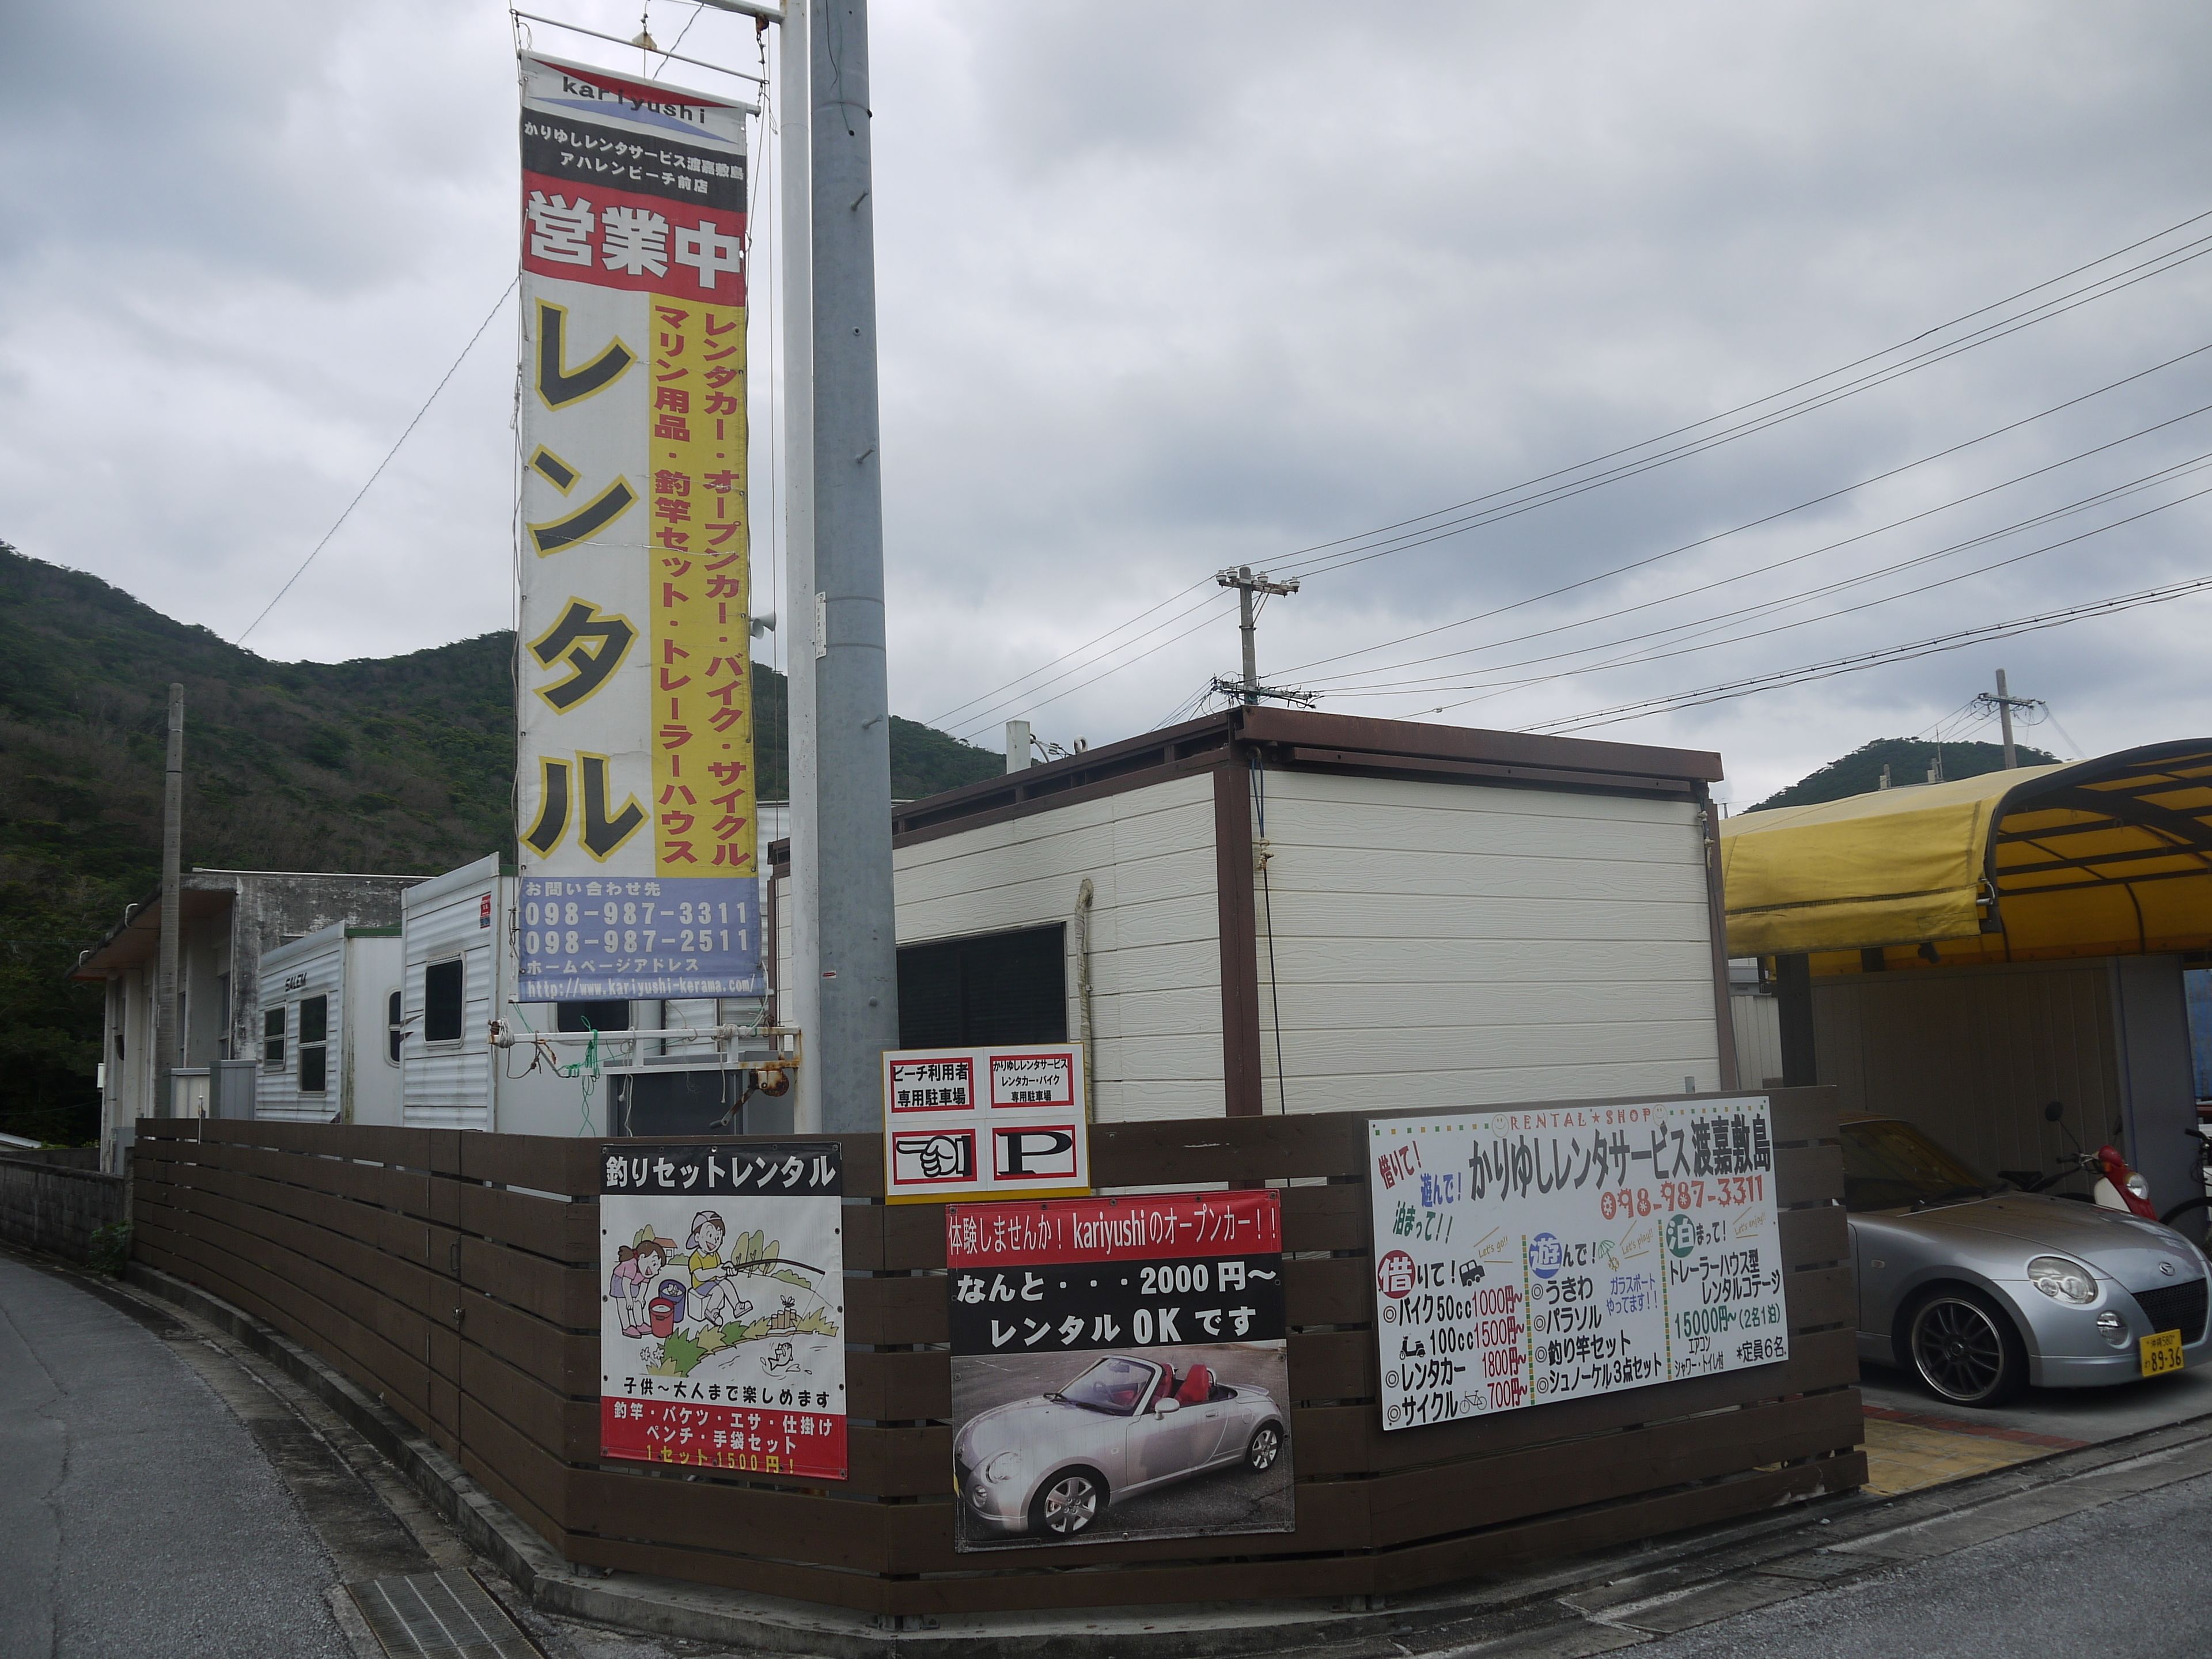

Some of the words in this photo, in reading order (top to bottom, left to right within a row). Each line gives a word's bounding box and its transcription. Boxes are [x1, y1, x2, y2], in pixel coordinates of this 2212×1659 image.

[563, 76, 705, 124] kariyushi
[560, 151, 708, 194] アハレンビーチ前店
[528, 190, 741, 289] 営業中
[520, 297, 650, 862] レンタル
[526, 881, 661, 897] お問い合わせ先
[525, 902, 747, 926] 098-987-3311
[525, 929, 748, 954] 098-987-2511
[527, 958, 699, 975] ホームページアドレス
[528, 974, 756, 999] http://www.kariyushi-kerama.com/
[897, 1087, 966, 1107] 専用駐車場
[1011, 1090, 1052, 1103] 専用駐車場
[996, 1131, 1073, 1176] P
[1469, 1113, 1771, 1202] かりゆしレンタサービス渡嘉敷島
[606, 1155, 836, 1189] 釣りセットレンタル
[1601, 1175, 1763, 1220] 098-987-3311
[1671, 1248, 1760, 1286] トレーラーハウス型
[1546, 1275, 1593, 1305] うきわ
[1702, 1269, 1781, 1305] レンタルコテージ
[1546, 1305, 1602, 1335] パラソル
[1548, 1330, 1631, 1366] 釣り竿セット
[1688, 1335, 1711, 1355] エアコン
[1402, 1357, 1466, 1391] レンタカー
[1550, 1352, 1662, 1393] シュノーケル3点セット
[1402, 1391, 1459, 1426] サイクル
